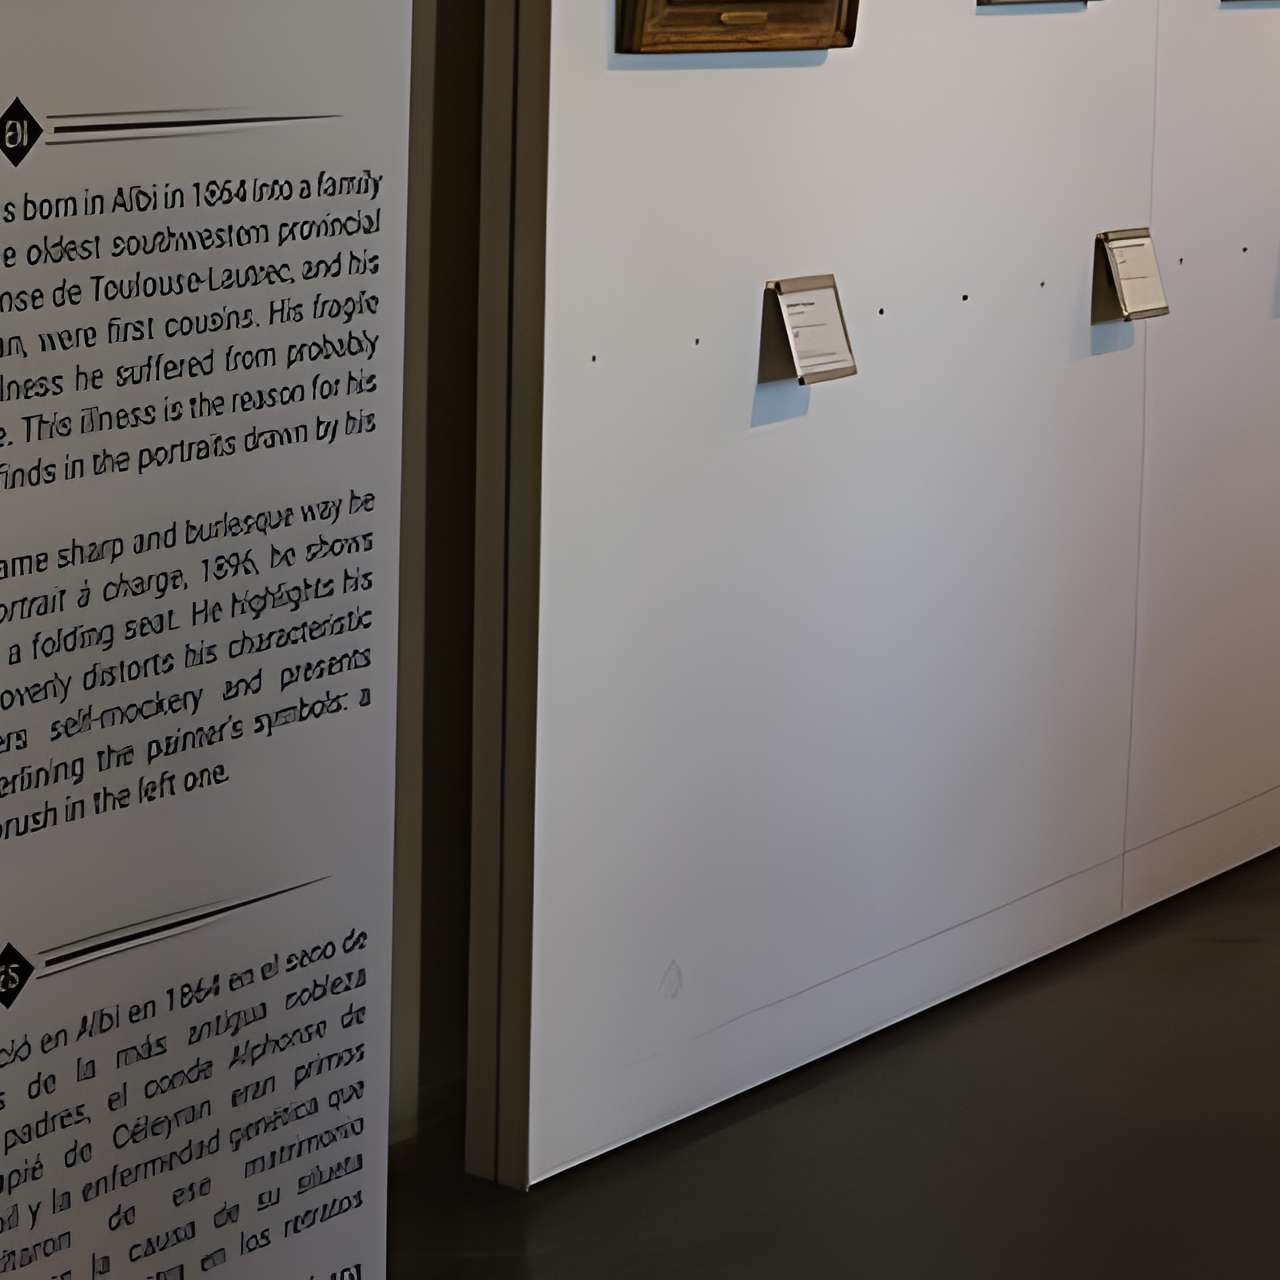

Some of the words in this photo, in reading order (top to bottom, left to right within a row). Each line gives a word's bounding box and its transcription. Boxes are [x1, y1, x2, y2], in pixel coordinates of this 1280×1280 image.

[84, 188, 105, 216] in
[52, 277, 82, 308] de
[75, 364, 104, 392] he
